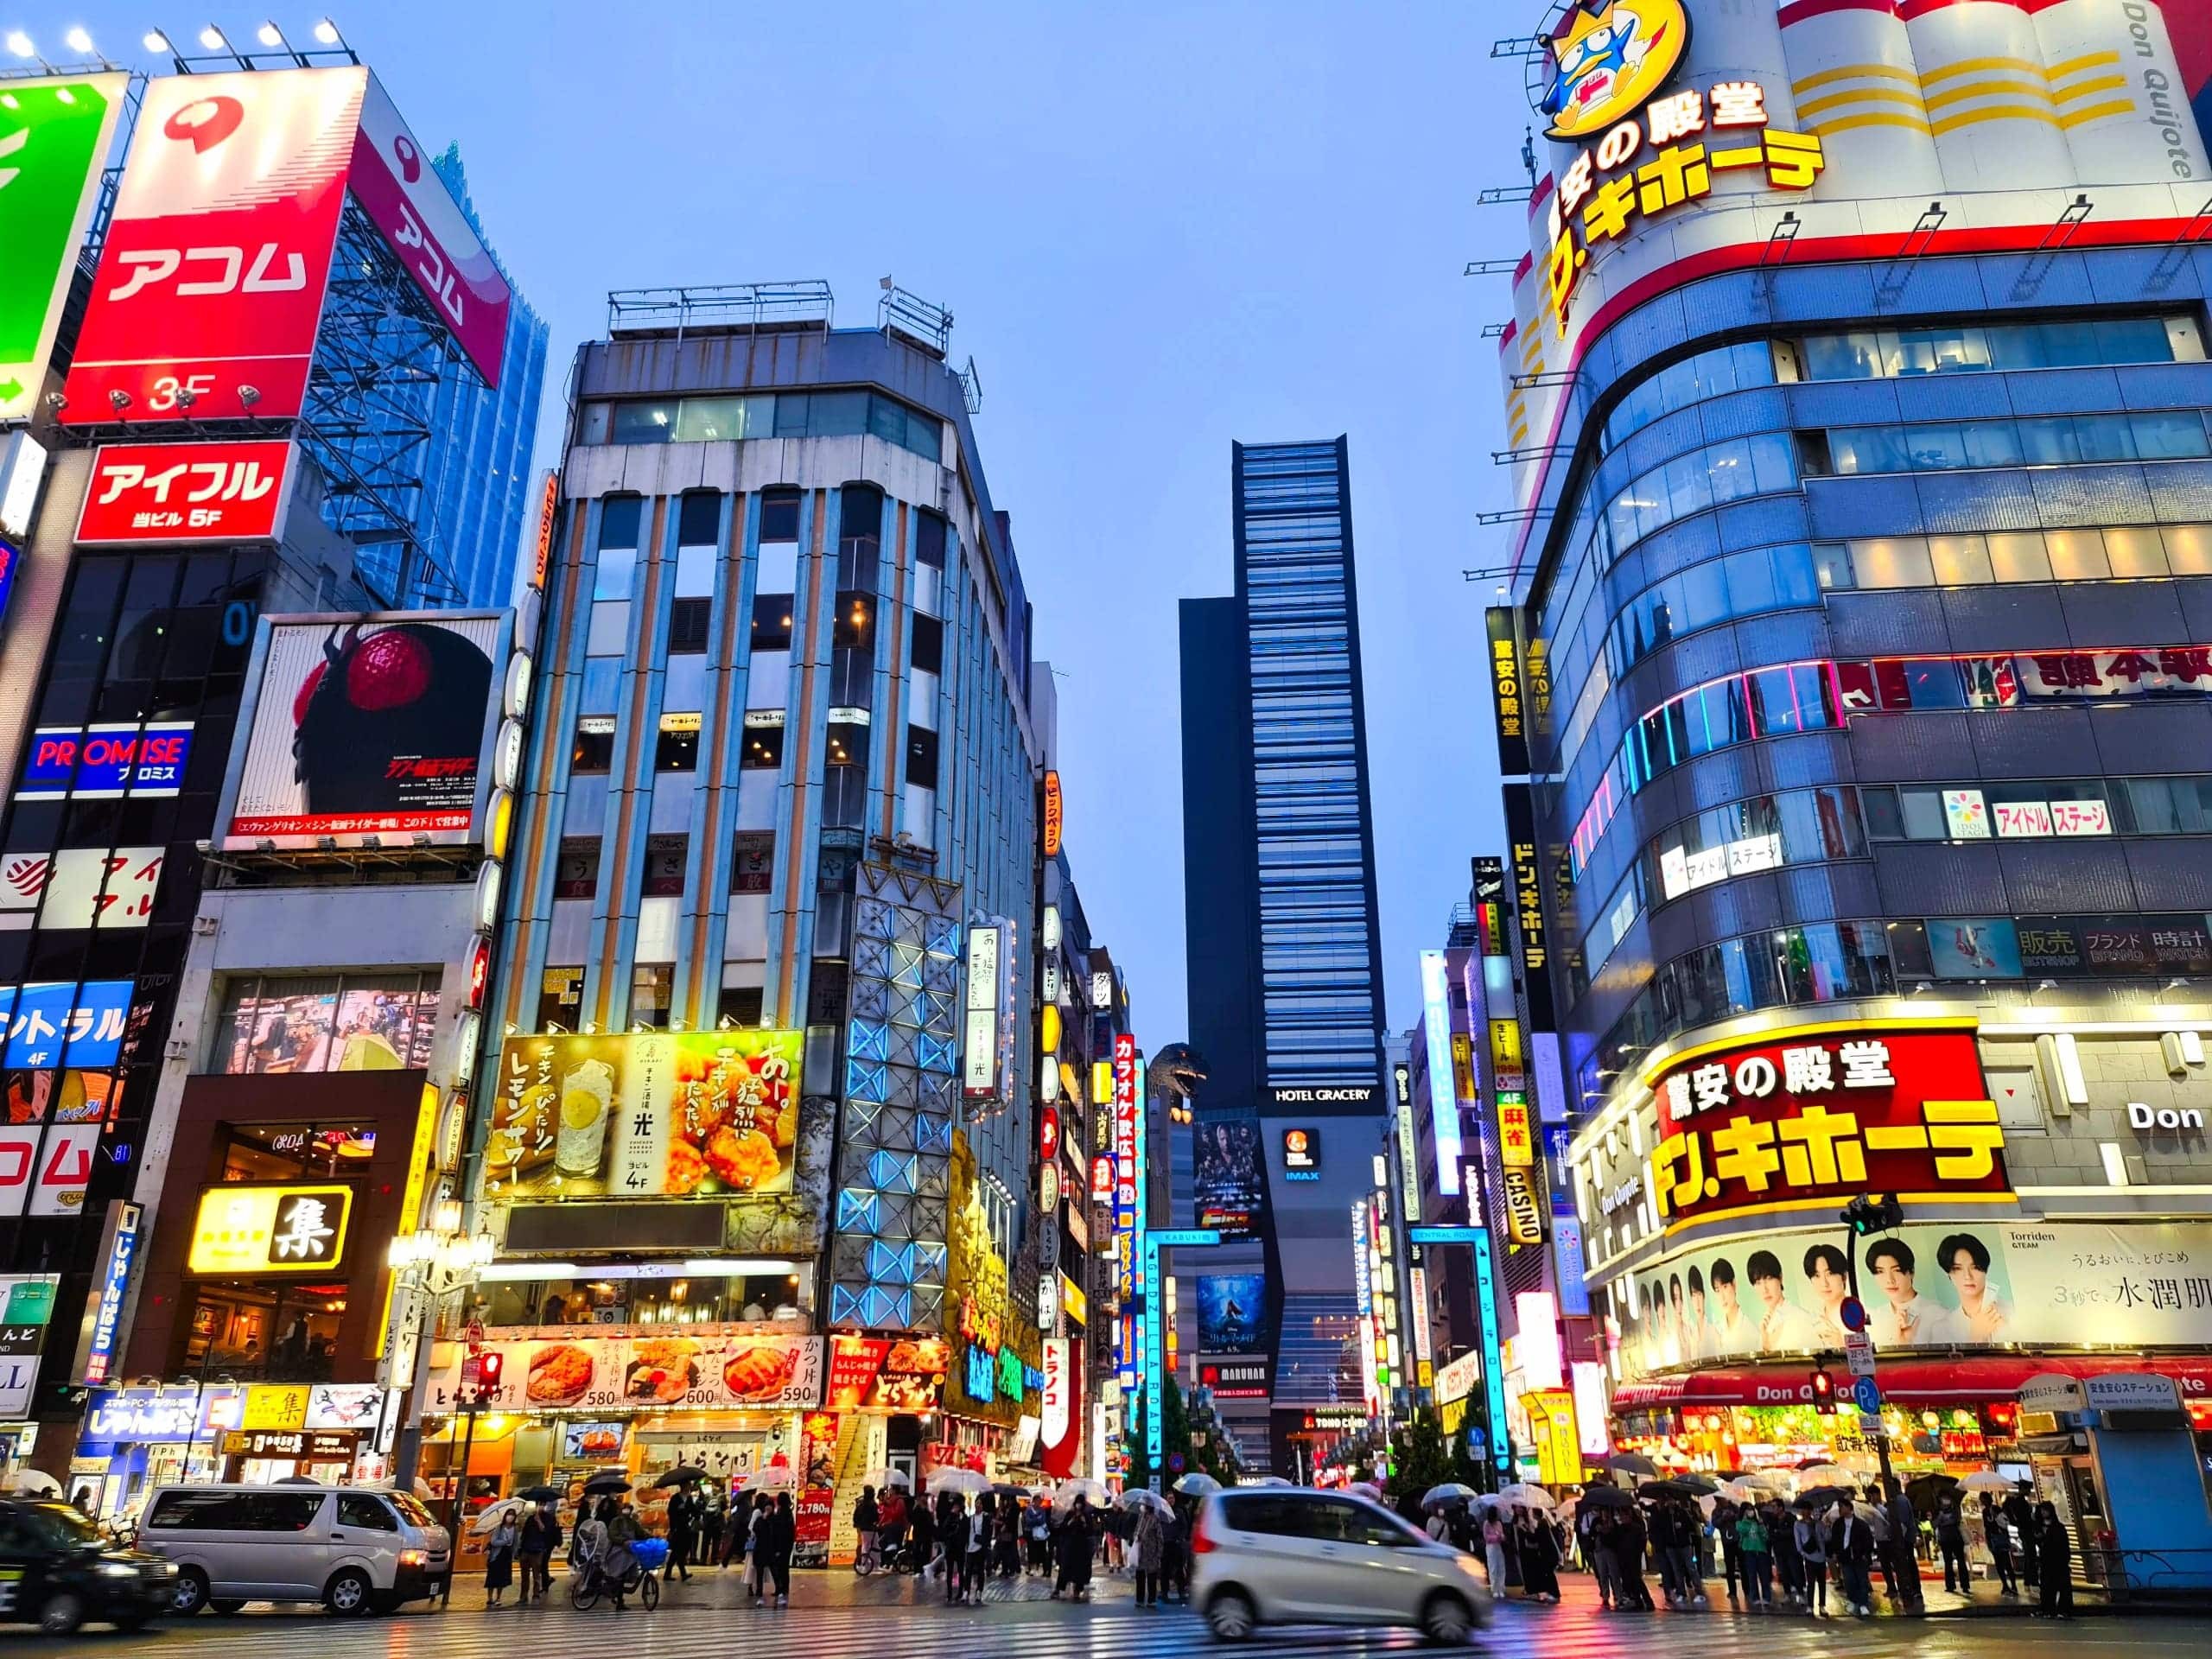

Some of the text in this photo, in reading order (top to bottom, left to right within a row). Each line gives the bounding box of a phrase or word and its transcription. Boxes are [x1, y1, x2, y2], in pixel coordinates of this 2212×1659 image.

[2122, 2, 2192, 179] Don Quijote
[1548, 81, 1768, 249] 安の殿堂
[107, 243, 307, 302] アコム
[395, 203, 463, 327] アコム
[149, 372, 216, 411] 3F
[99, 461, 274, 505] アイフル
[131, 509, 223, 529] 当ビル 5F
[1493, 639, 1522, 736] 驚安の殿堂
[37, 738, 184, 766] PROMISE
[118, 766, 175, 781] プロミス
[1998, 805, 2106, 834] アイドル ステージ
[2018, 929, 2075, 955] 販売
[2086, 933, 2141, 950] ブランド
[2152, 930, 2206, 948] 時計
[0, 1007, 126, 1046] ントラル
[1497, 1024, 1510, 1061] 生ビール
[28, 1052, 49, 1065] 4F
[1665, 1039, 1897, 1123] 驚安の殿堂
[1275, 1090, 1370, 1102] HOTEL GRACERY
[1502, 1093, 1522, 1103] 4F
[504, 1052, 531, 1186] レモンサワー
[634, 1113, 654, 1136] 光
[1503, 1108, 1526, 1147] 麻雀
[2127, 1102, 2203, 1131] Don
[626, 1171, 648, 1190] 4F
[1286, 1172, 1319, 1181] IMAX
[1505, 1171, 1540, 1238] CASINO
[275, 1197, 334, 1258] 集
[2010, 1231, 2056, 1243] Torriden
[803, 1338, 819, 1384] かつ丼
[1147, 1263, 1160, 1437] GODZILLA ROAD
[1045, 1344, 1059, 1406] トラノコ
[2089, 1382, 2171, 1393] 安全安心ステーション
[588, 1390, 622, 1406] 580円
[687, 1389, 721, 1404] 600円
[783, 1387, 817, 1402] 590円
[1757, 1385, 1794, 1401] Don
[276, 1392, 302, 1423] 集
[1835, 1434, 1904, 1454] 歌舞伎店
[677, 1449, 753, 1471] とらそば
